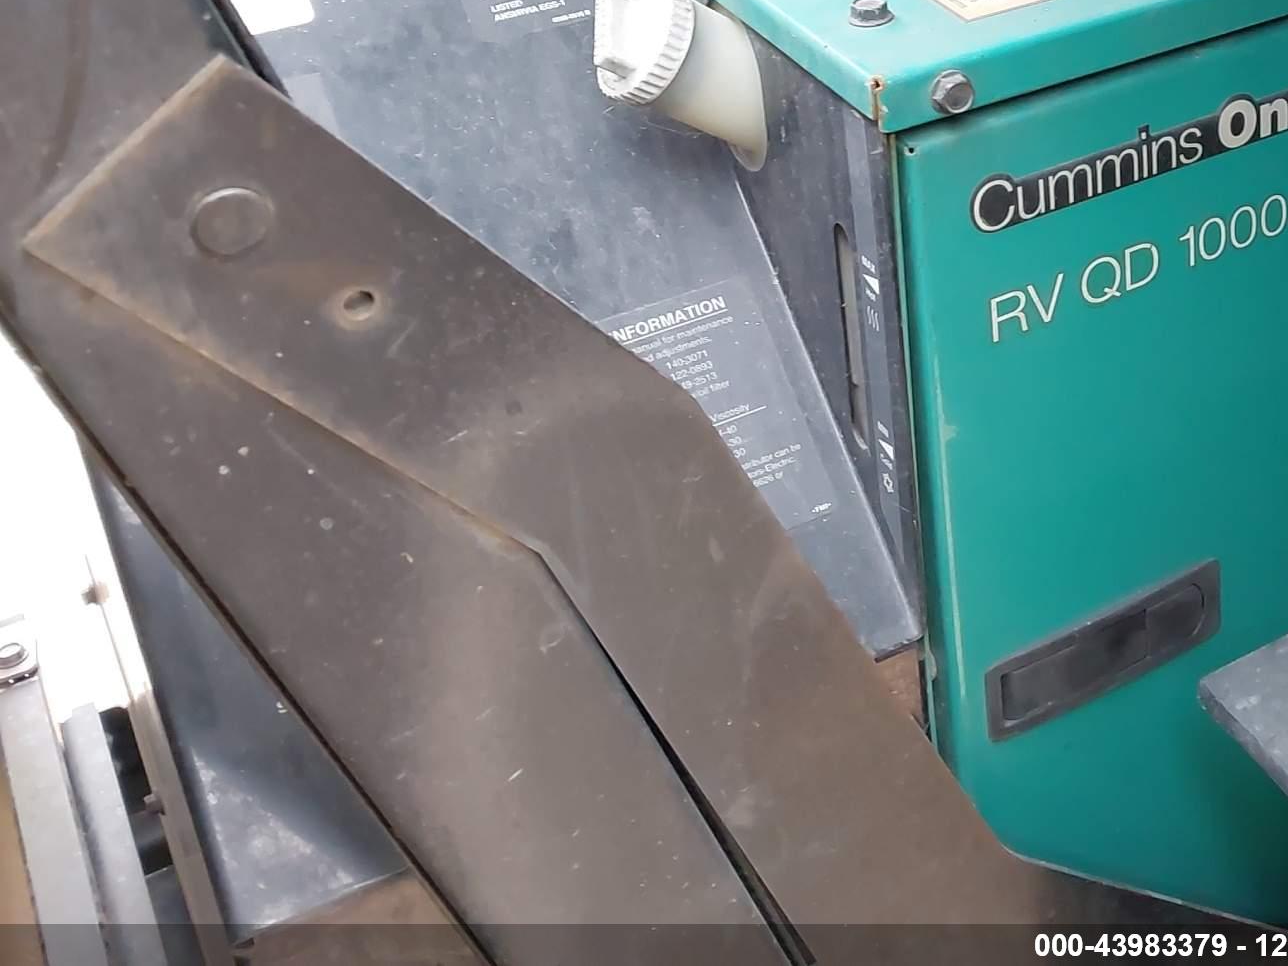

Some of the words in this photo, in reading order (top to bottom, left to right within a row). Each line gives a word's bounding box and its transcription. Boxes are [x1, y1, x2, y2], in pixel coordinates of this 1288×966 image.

[973, 126, 1202, 232] Cummins
[989, 273, 1065, 343] RV
[1080, 242, 1160, 304] QD
[608, 296, 726, 341] NFORMATION
[677, 316, 734, 339] maintenance
[774, 447, 790, 458] can
